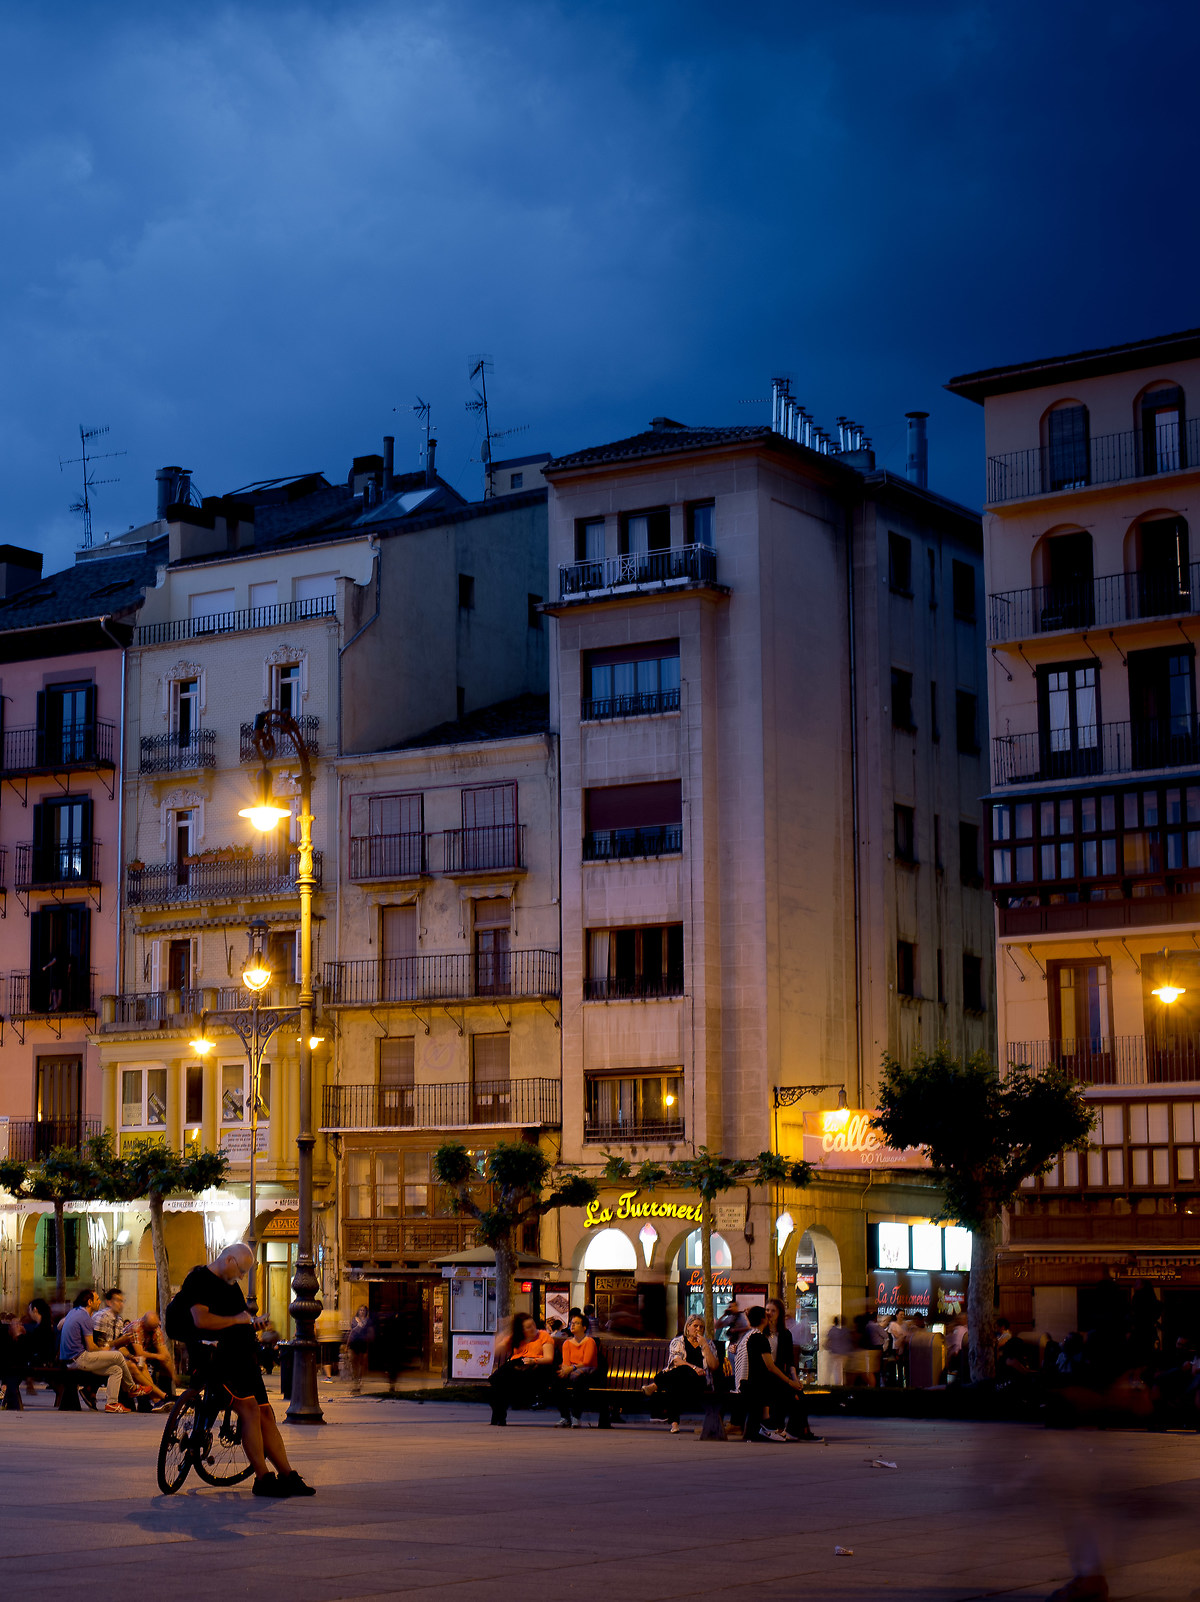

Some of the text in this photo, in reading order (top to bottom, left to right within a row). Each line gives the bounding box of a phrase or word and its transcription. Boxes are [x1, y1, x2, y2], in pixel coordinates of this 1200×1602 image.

[822, 1114, 881, 1153] calle
[583, 1199, 614, 1229] La
[1127, 1267, 1176, 1277] TABACOS
[874, 1282, 888, 1305] La
